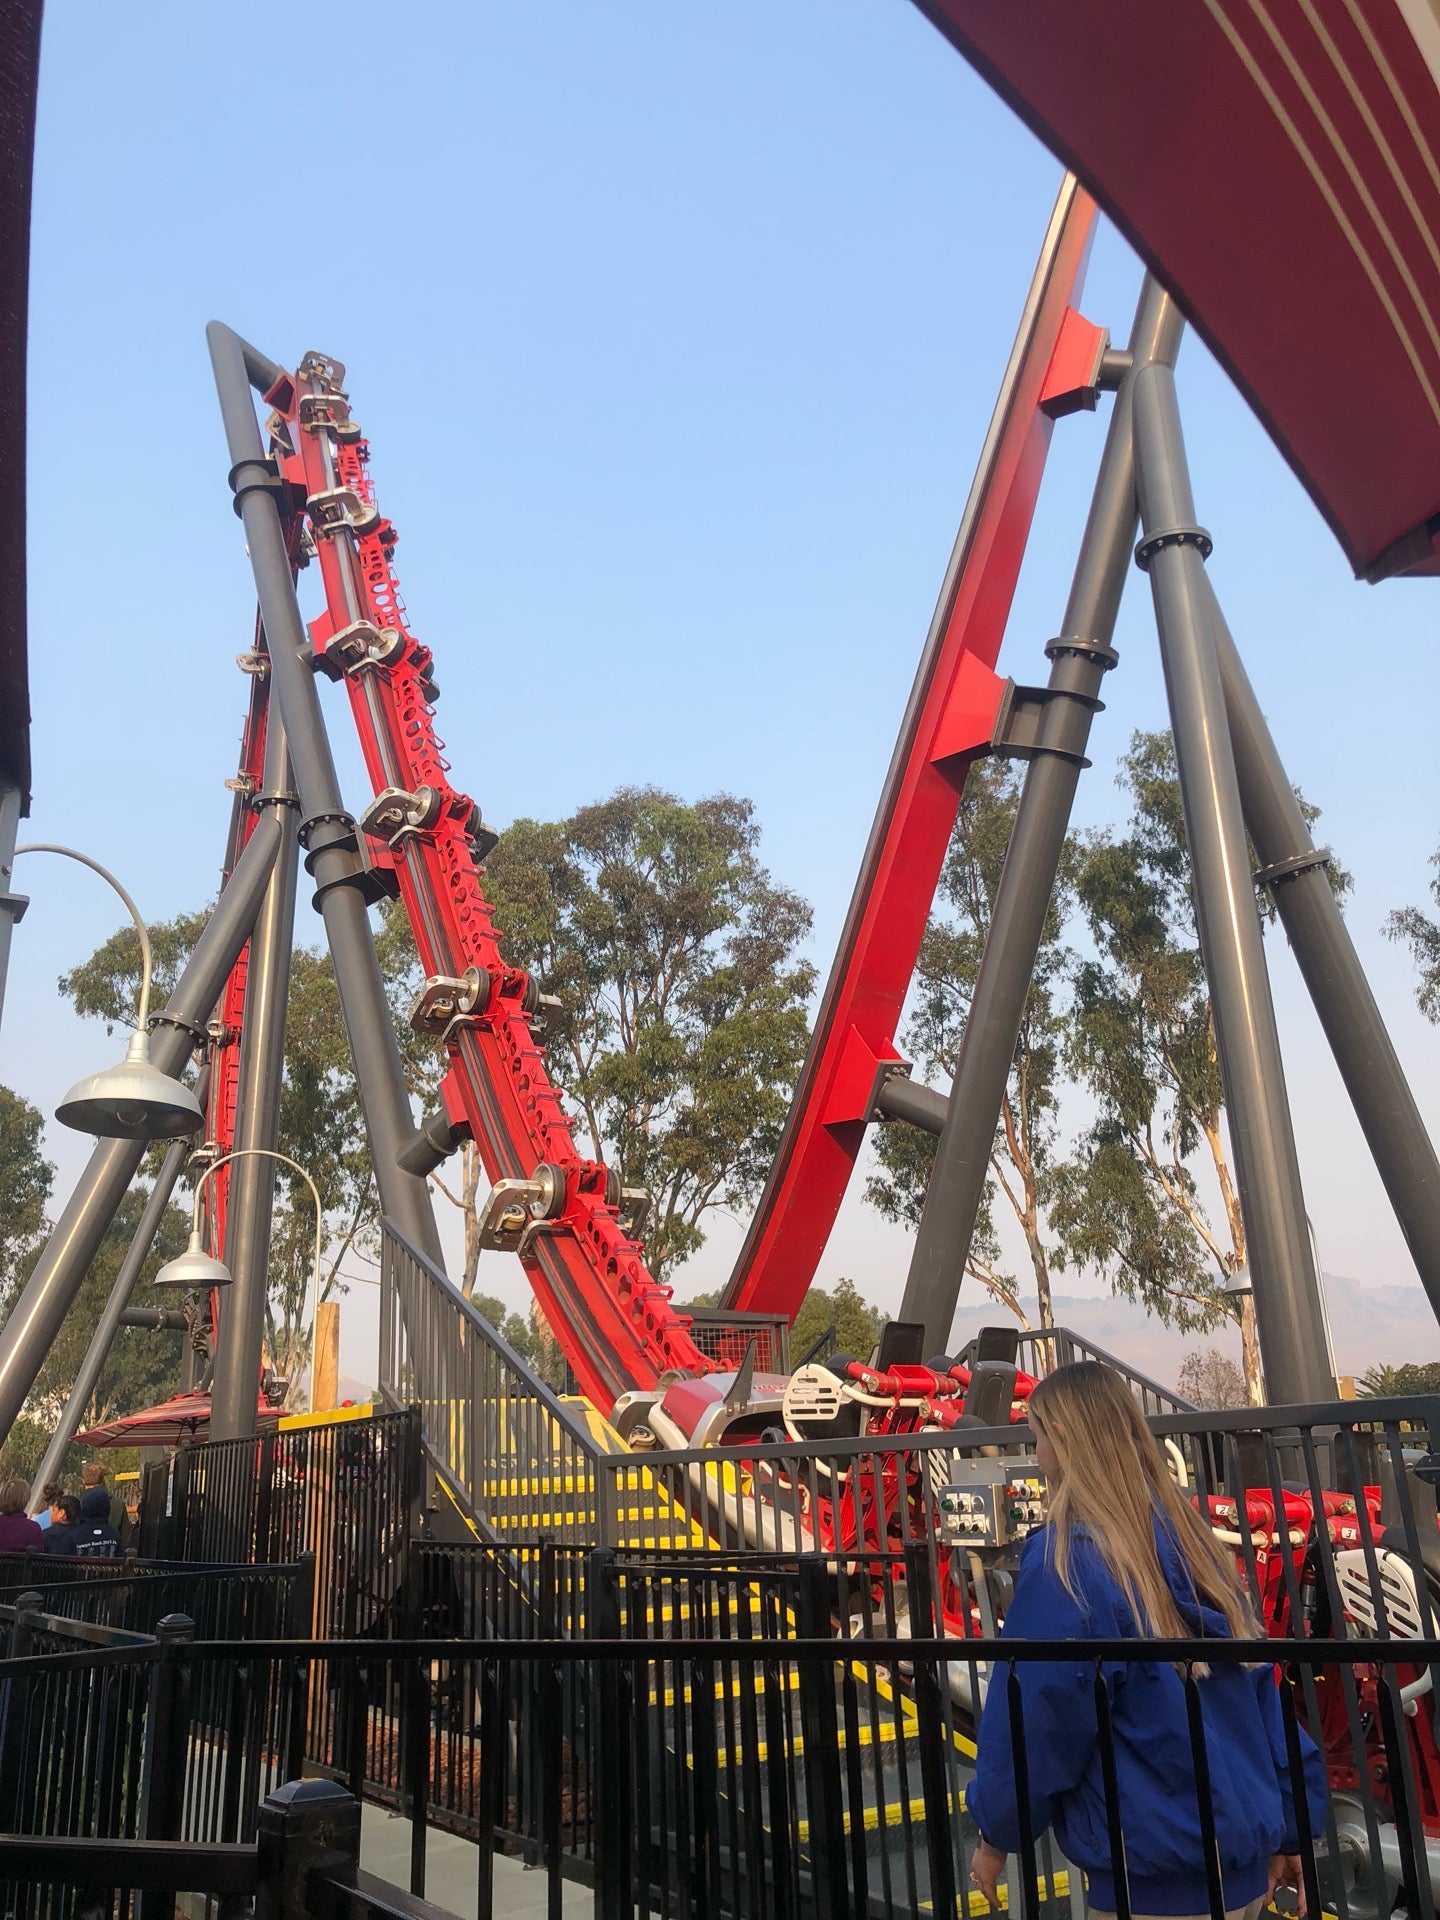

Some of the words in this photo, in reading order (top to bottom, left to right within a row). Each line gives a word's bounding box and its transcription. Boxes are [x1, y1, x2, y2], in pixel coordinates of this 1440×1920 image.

[1219, 1506, 1226, 1515] 2
[1345, 1529, 1352, 1538] 3
[1258, 1553, 1265, 1562] A
